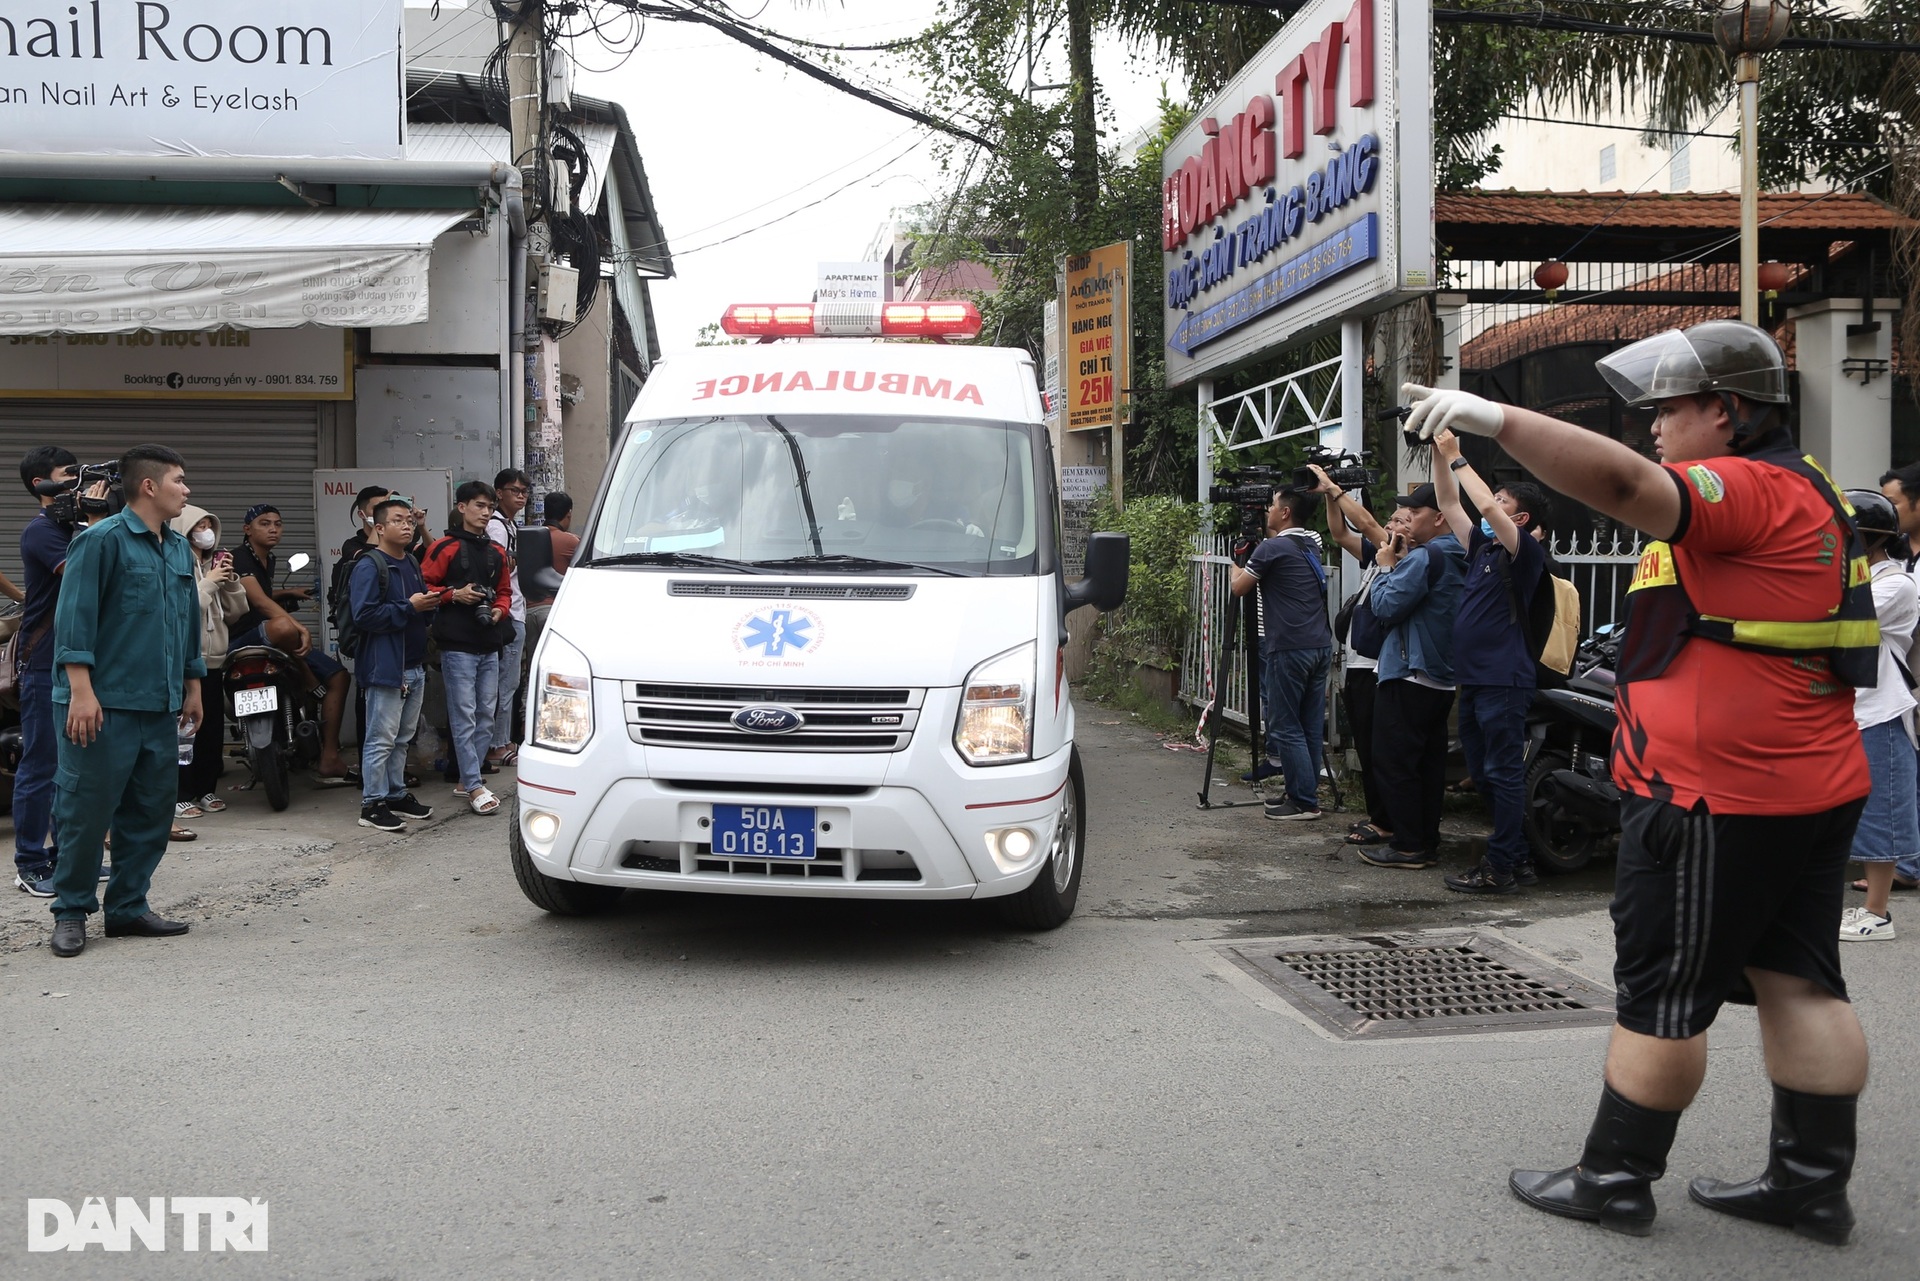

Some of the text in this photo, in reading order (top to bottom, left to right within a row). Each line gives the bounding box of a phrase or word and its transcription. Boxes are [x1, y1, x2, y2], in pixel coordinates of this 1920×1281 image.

[136, 2, 333, 66] Room
[42, 82, 96, 106] Nail
[109, 84, 149, 107] Art
[162, 85, 180, 108] &
[194, 86, 299, 113] Eyelash
[1162, 94, 1276, 252] HOÀNG
[1168, 133, 1380, 311] ĐẶC SẢN TRẢNG BÀNG
[1069, 255, 1091, 273] SHOP
[123, 260, 269, 296] Vy
[302, 288, 418, 302] Booking: dương yến vy
[819, 288, 847, 299] May's
[1070, 280, 1092, 298] Anh
[321, 304, 416, 316] 0901.834.759
[1088, 299, 1105, 307] TRANG
[33, 308, 100, 327] TẠO
[110, 306, 176, 325] HỌC
[187, 302, 267, 319] VIÊN
[1072, 318, 1094, 334] HÀNG
[161, 330, 201, 349] HỌC
[1080, 337, 1094, 354] GIÁ
[1080, 355, 1097, 376] CHỈ
[124, 372, 338, 387] Booking: dương yến vy 0901. 834. 759
[1085, 468, 1093, 476] RA
[325, 482, 357, 496] NAIL
[1062, 484, 1081, 492] KHÔNG
[793, 604, 825, 631] EMERGENCY
[806, 631, 825, 654] CENTER
[241, 689, 269, 702] 59-X1
[238, 699, 274, 714] 935.31
[746, 709, 785, 728] Ford
[741, 807, 785, 831] 50A
[722, 831, 805, 855] 018.13
